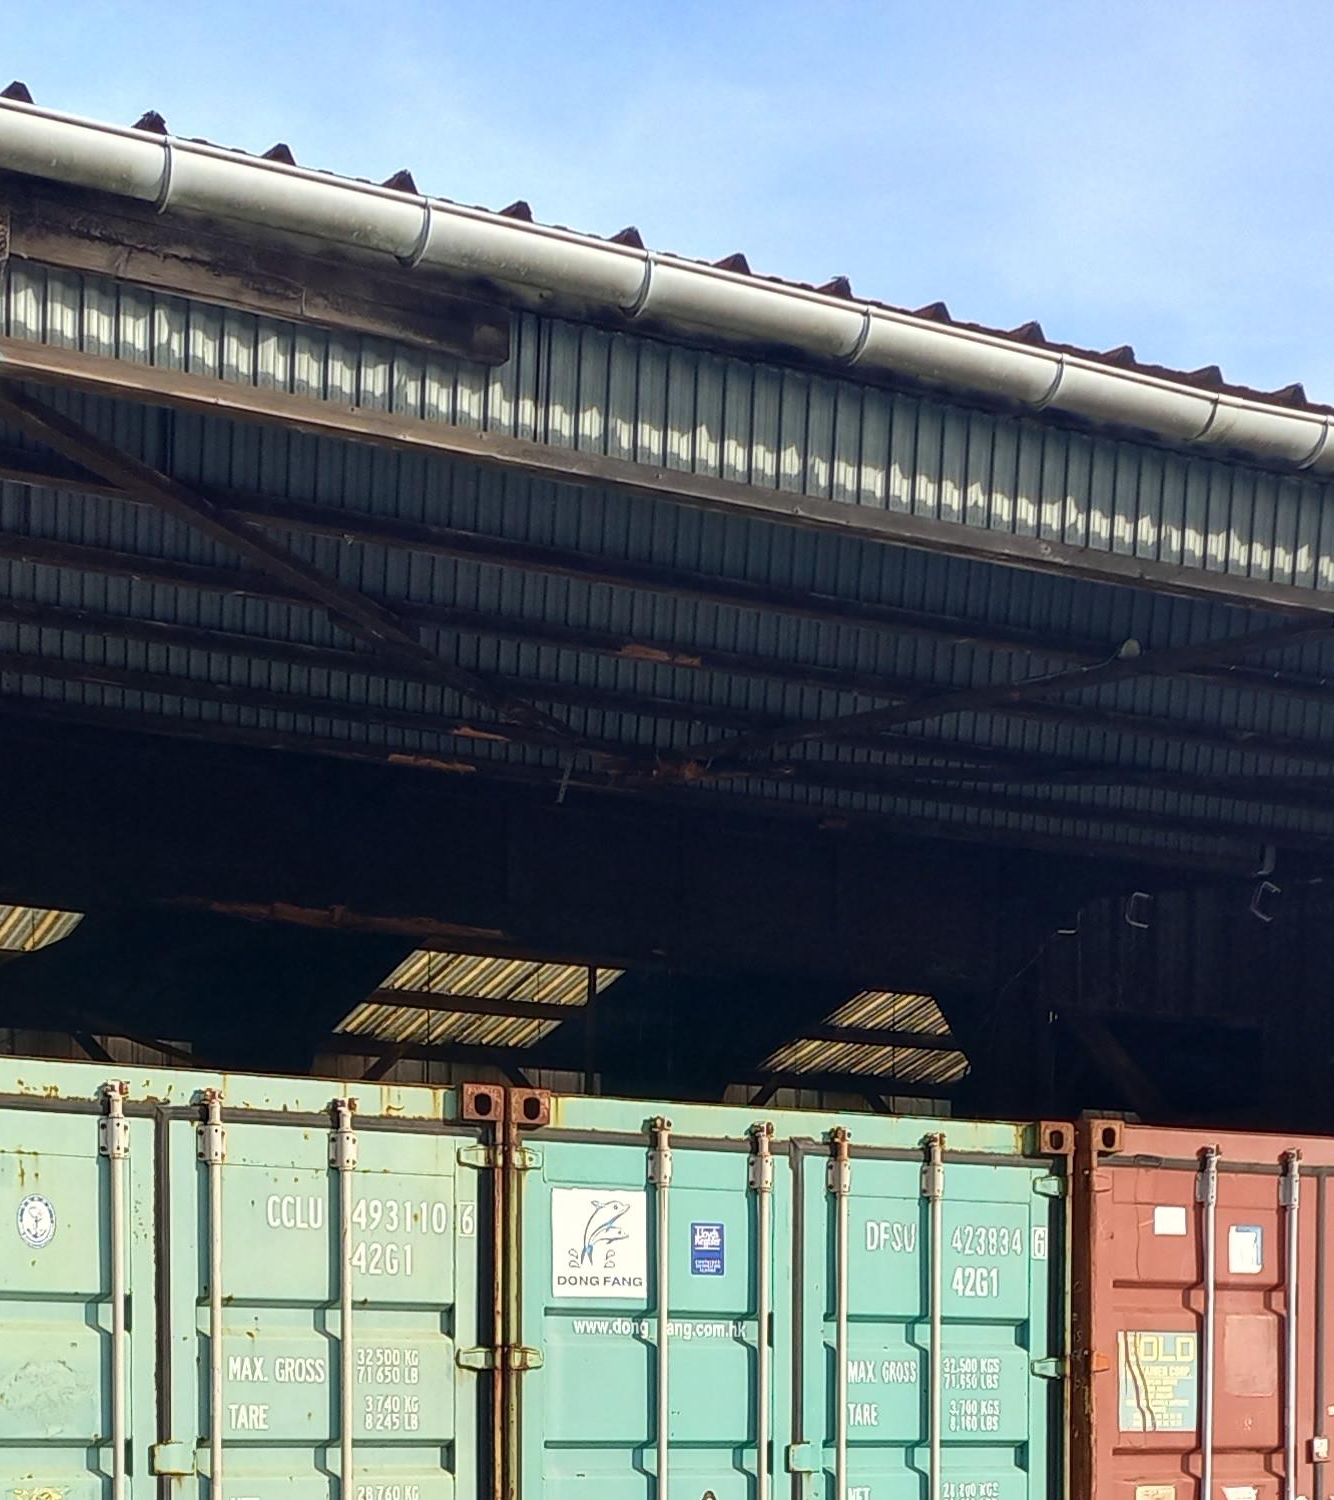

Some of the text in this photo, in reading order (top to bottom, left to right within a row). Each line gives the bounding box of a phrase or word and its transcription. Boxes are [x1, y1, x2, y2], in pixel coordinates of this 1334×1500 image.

[267, 1195, 475, 1236] CCLU 493110 6
[866, 1222, 1046, 1258] DFSU 423834 6
[351, 1242, 412, 1276] 42G1
[557, 1276, 643, 1287] DONG FANG
[952, 1267, 999, 1297] 42G1
[1131, 1336, 1195, 1361] OLD
[228, 1356, 268, 1382] MAX.
[275, 1358, 325, 1383] GROSS
[404, 1350, 419, 1366] KG
[404, 1367, 418, 1384] LB
[882, 1361, 917, 1383] GROSS
[981, 1358, 1000, 1373] KGS
[981, 1374, 998, 1389] LBS
[228, 1404, 269, 1430] TARE
[404, 1397, 419, 1413] KG
[404, 1415, 418, 1431] LB
[848, 1404, 878, 1426] TARE
[981, 1400, 1000, 1415] KGS
[981, 1416, 998, 1431] LBS
